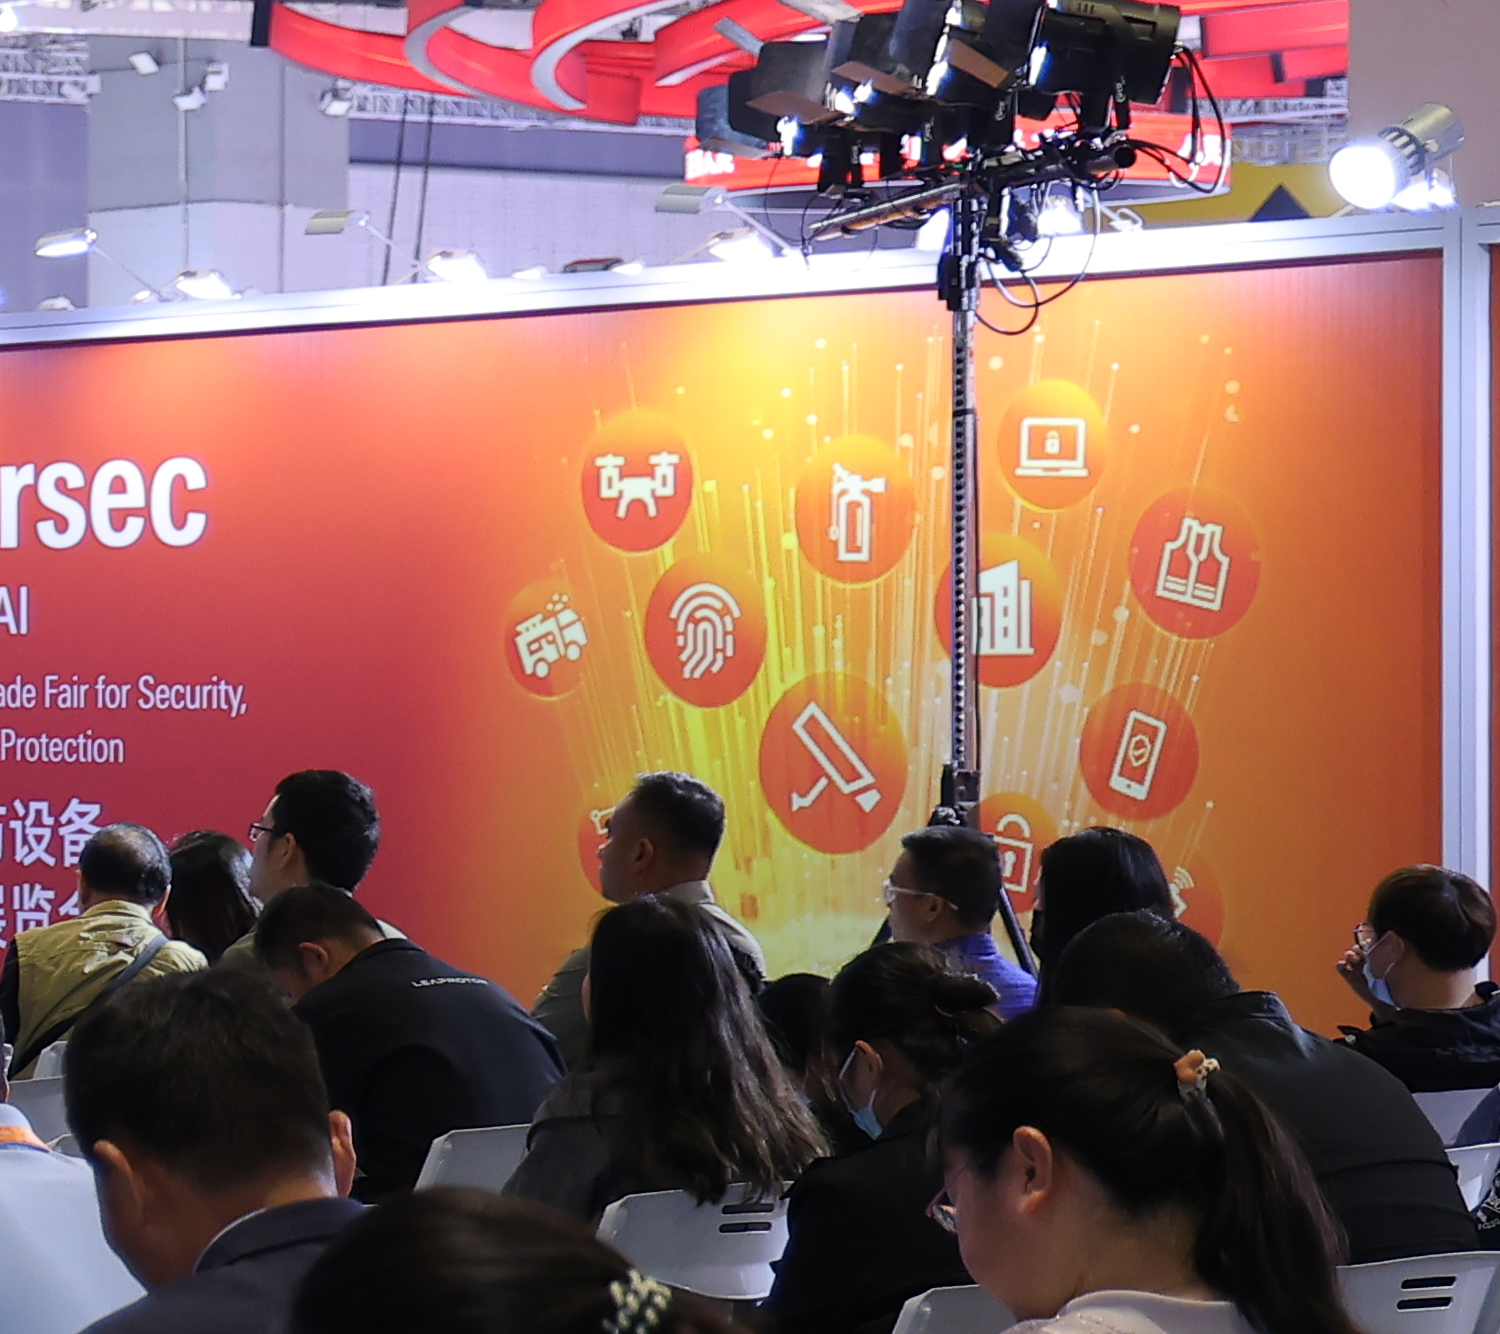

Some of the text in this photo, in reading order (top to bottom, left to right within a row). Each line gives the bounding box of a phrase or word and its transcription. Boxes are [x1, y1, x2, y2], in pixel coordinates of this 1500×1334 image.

[44, 676, 89, 710] Fair
[95, 676, 130, 710] for
[137, 677, 248, 717] Security,
[0, 729, 124, 764] Protection
